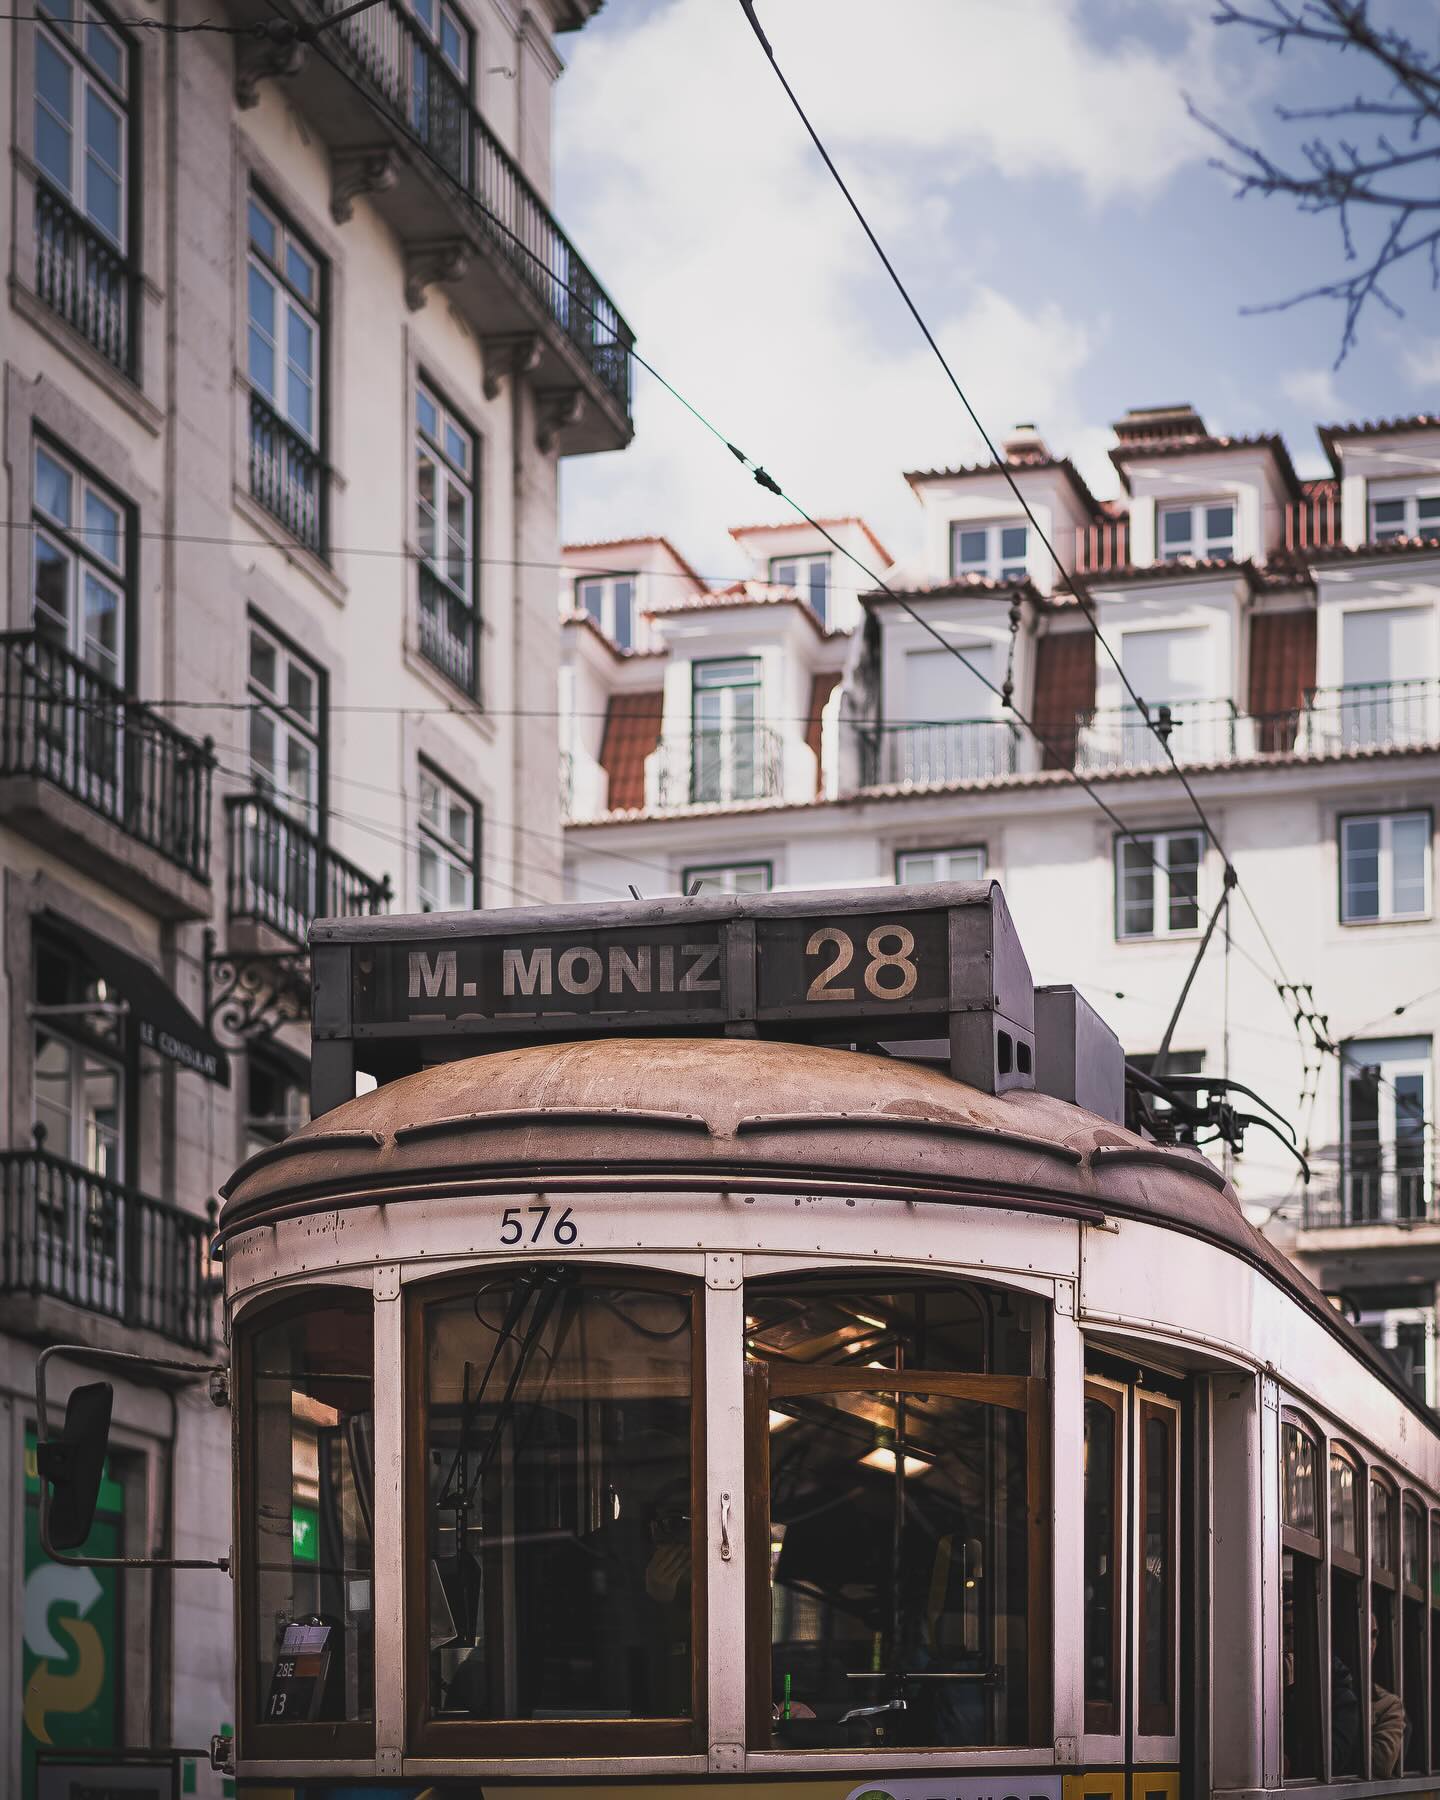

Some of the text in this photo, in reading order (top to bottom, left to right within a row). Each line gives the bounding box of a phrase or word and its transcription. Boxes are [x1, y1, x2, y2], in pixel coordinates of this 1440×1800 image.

[408, 944, 721, 998] M. MONIZ
[805, 924, 918, 1001] 28
[499, 1206, 578, 1246] 576
[276, 1662, 295, 1678] 28E
[269, 1692, 287, 1716] 13
